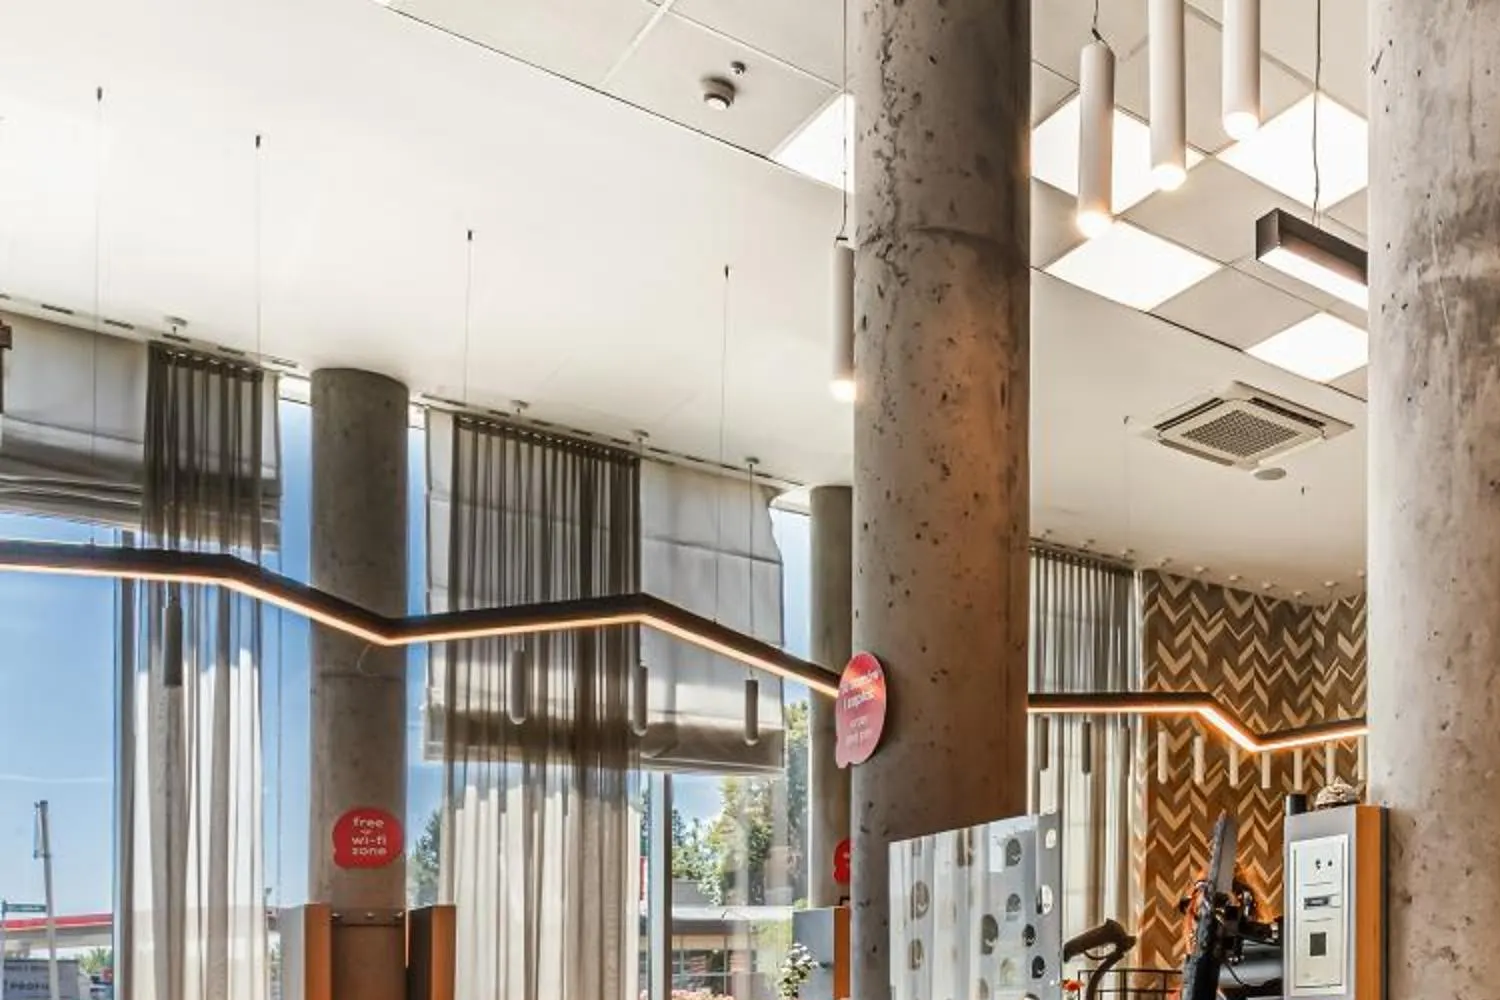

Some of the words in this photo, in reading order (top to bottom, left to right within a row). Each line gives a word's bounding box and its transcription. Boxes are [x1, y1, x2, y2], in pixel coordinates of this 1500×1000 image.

[353, 815, 385, 828] free
[352, 836, 387, 845] wi-fi
[352, 847, 387, 856] zone
